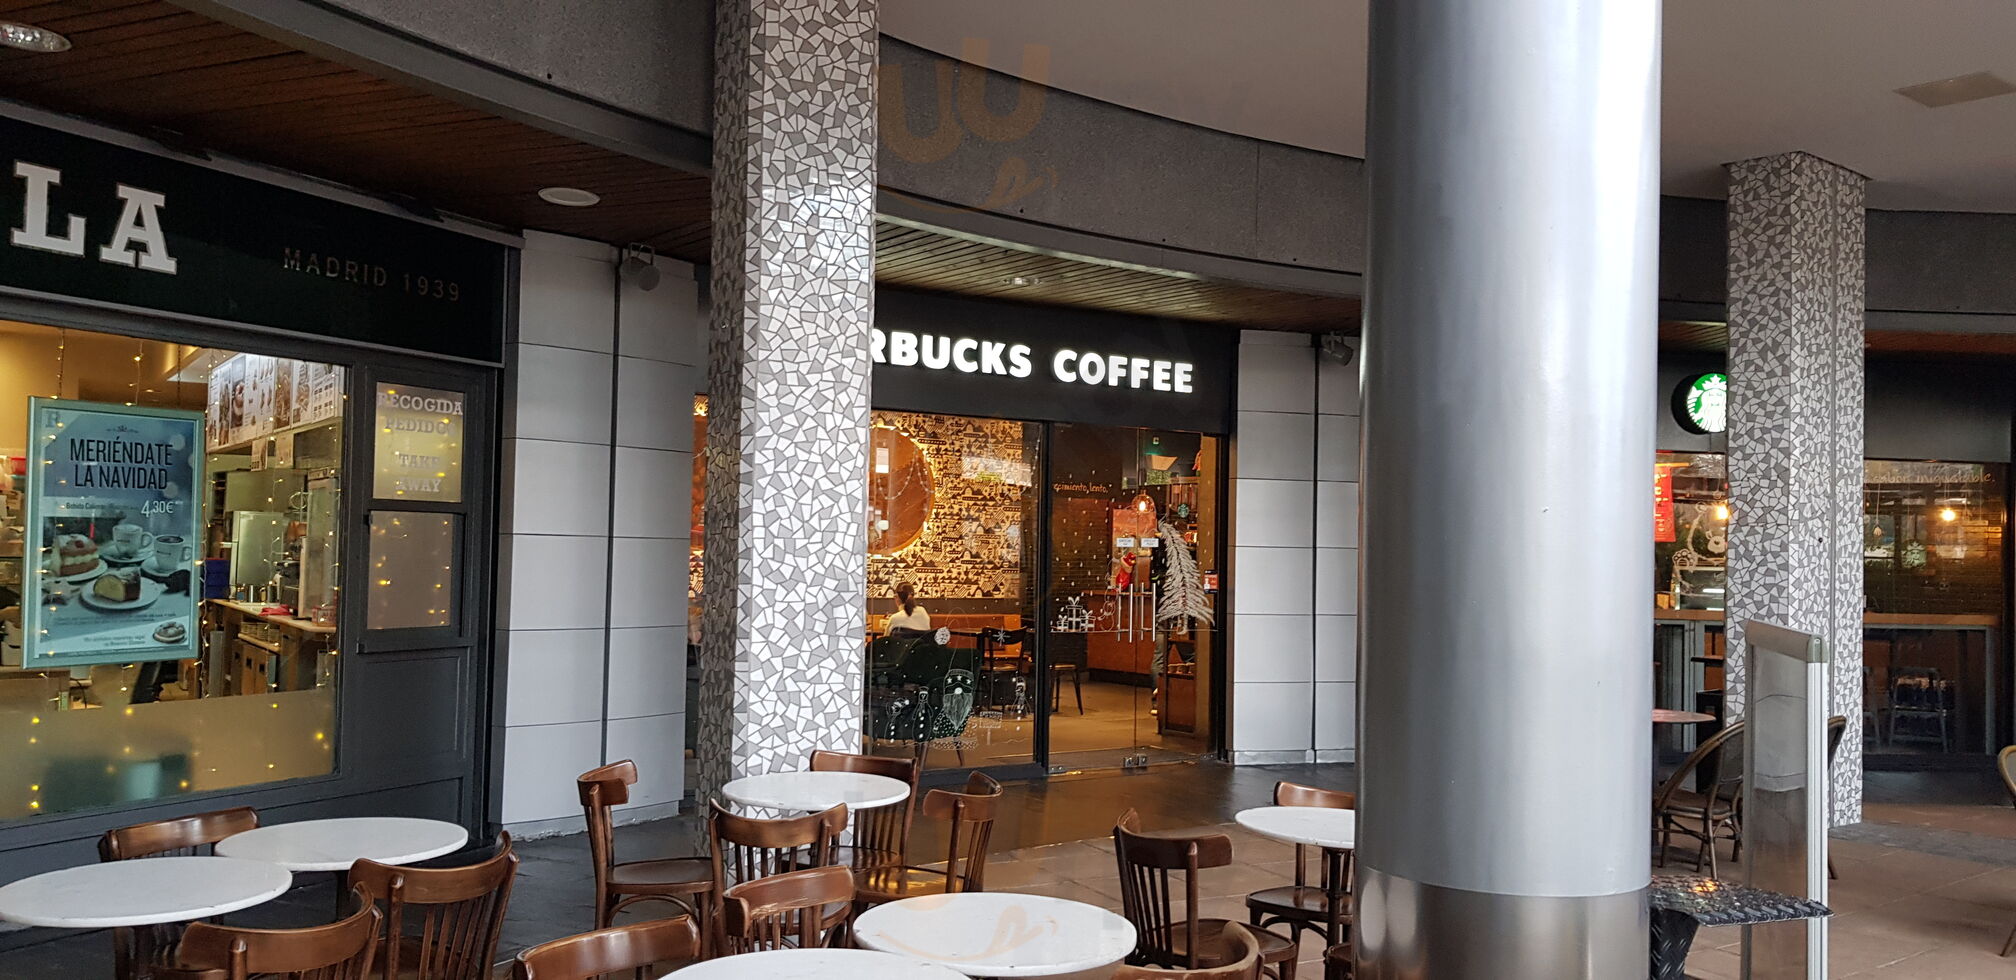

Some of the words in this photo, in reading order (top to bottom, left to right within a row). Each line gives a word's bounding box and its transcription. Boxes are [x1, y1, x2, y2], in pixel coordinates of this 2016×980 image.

[10, 160, 177, 274] LA
[283, 246, 388, 288] MADRID
[402, 273, 460, 302] 1939
[1053, 349, 1194, 394] COFFEE
[70, 437, 174, 466] MERIÉNDATE
[74, 465, 95, 488] LA
[98, 465, 168, 490] NAVIDAD
